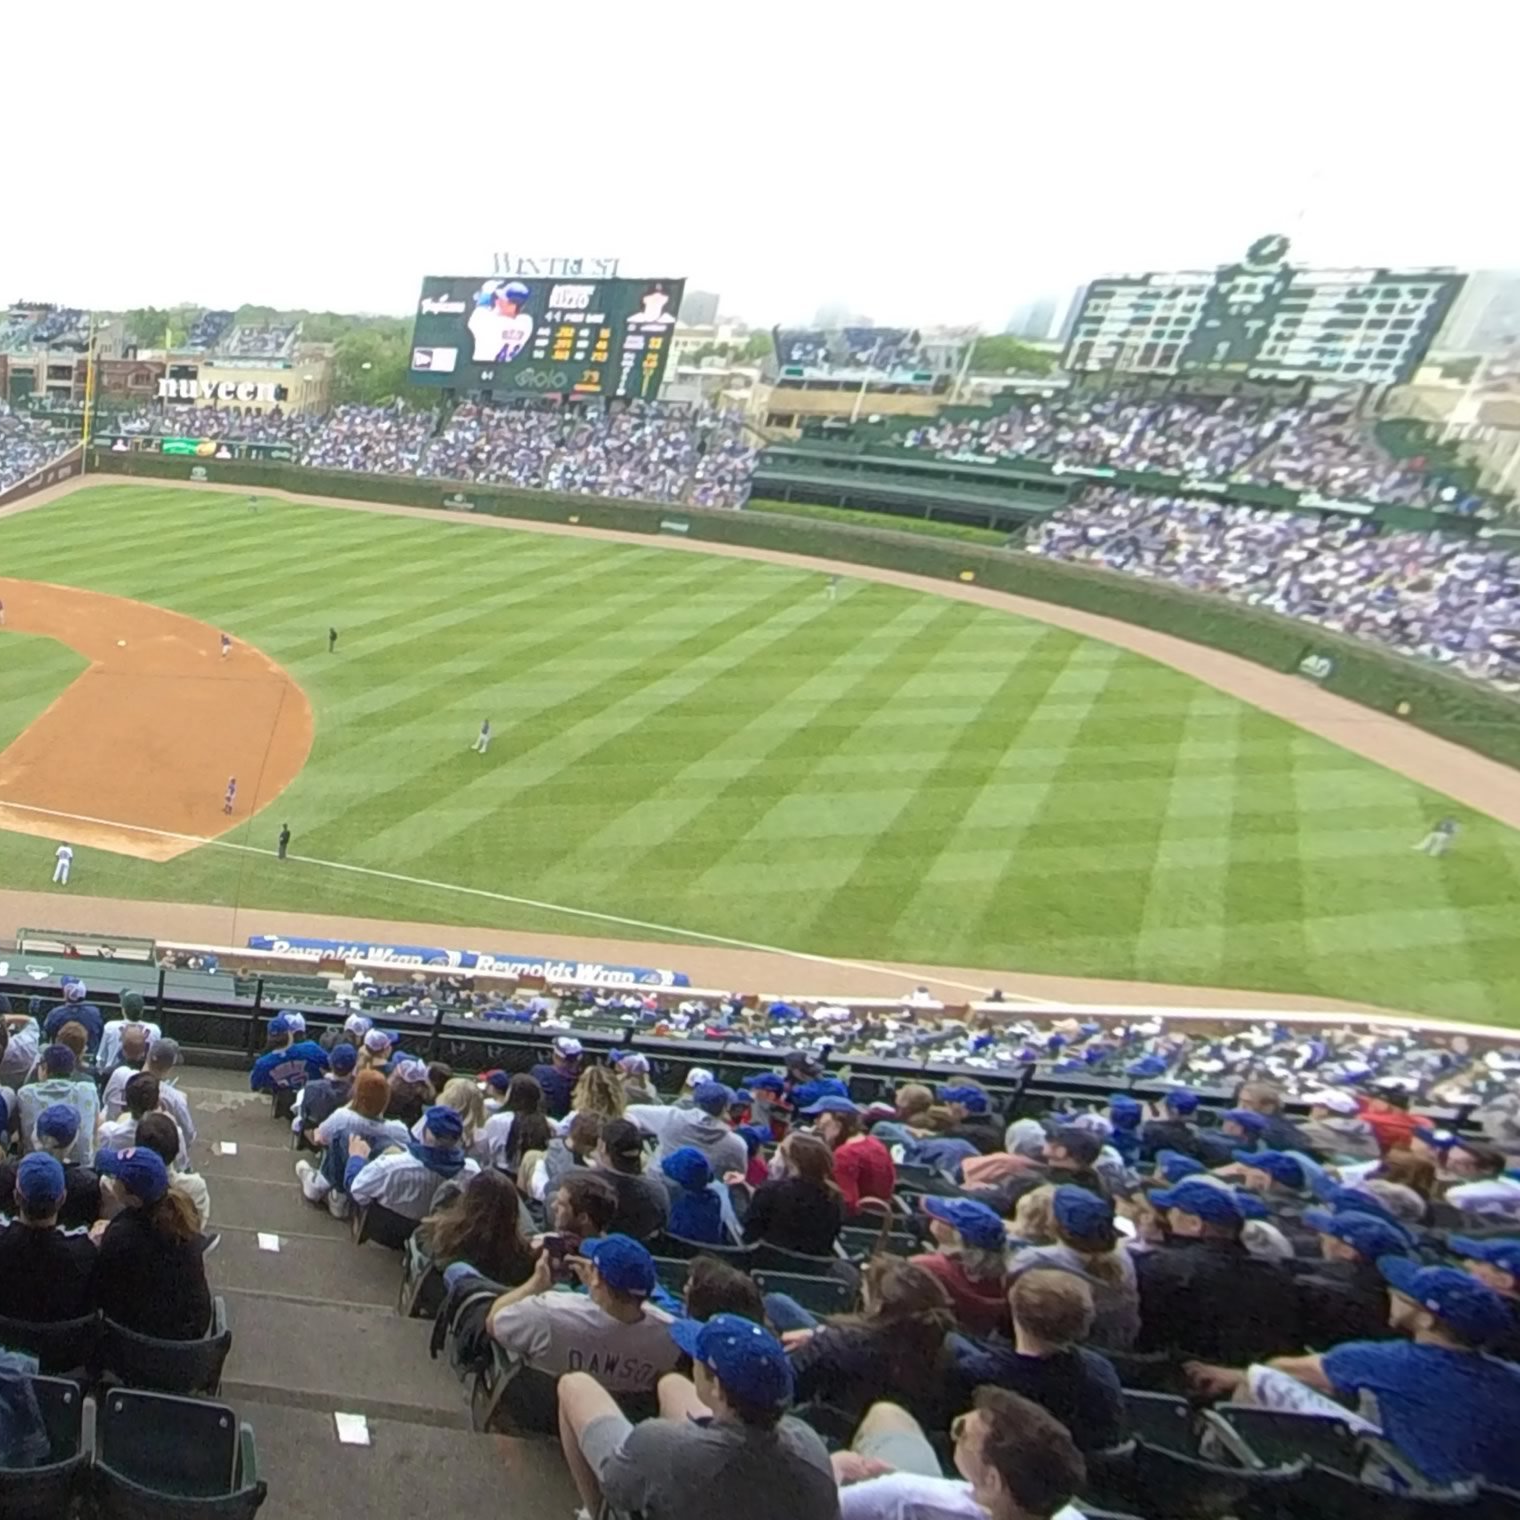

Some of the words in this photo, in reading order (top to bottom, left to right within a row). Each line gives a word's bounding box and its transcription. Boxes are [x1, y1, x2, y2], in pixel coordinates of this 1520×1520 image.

[157, 377, 277, 402] nuveen
[272, 941, 366, 961] Reynolds
[476, 955, 575, 979] Reynolds
[577, 963, 636, 983] Wrap
